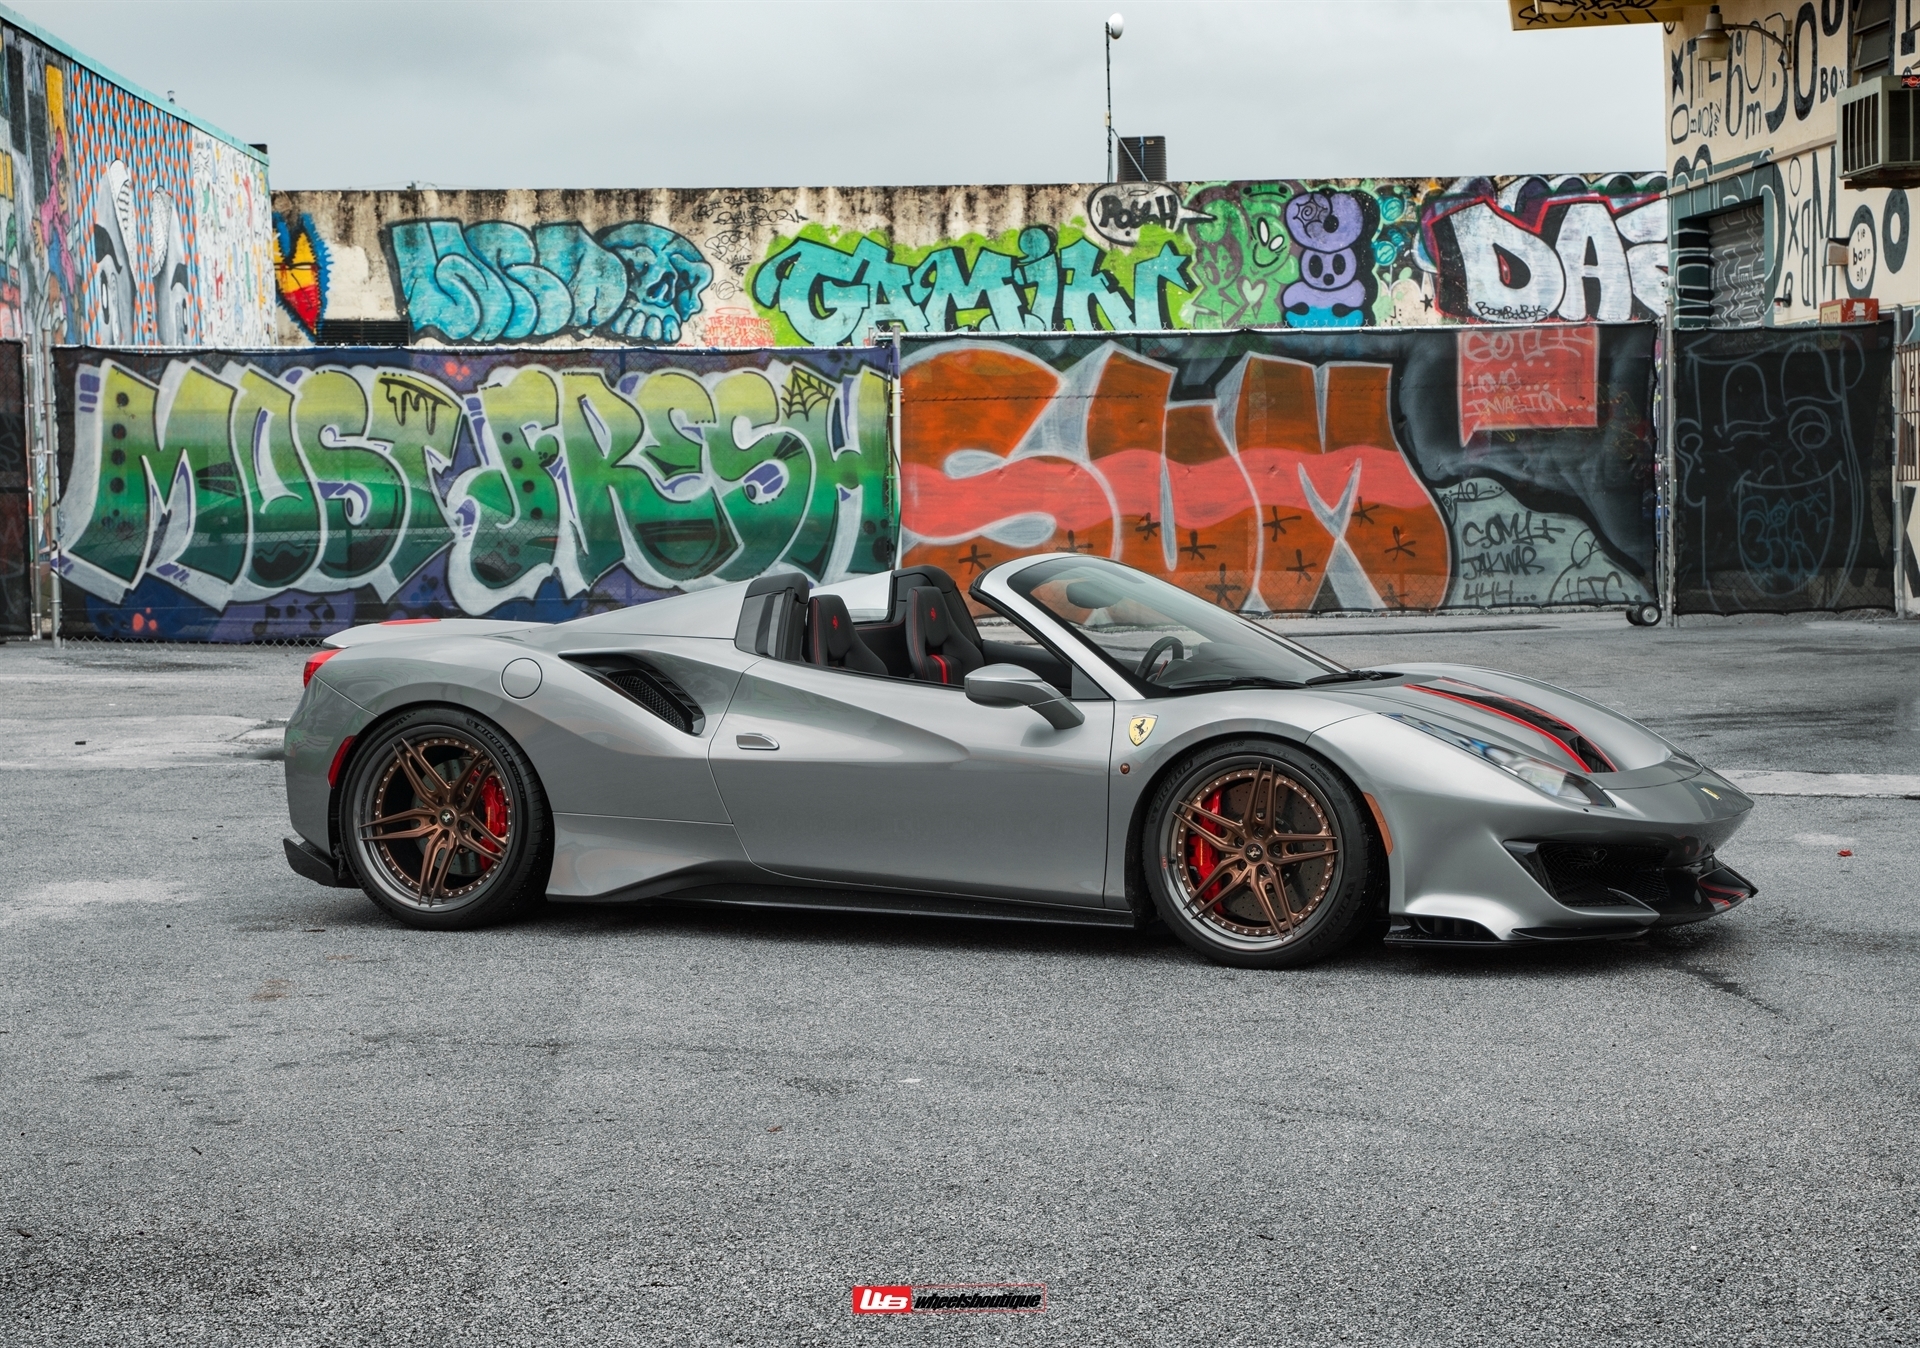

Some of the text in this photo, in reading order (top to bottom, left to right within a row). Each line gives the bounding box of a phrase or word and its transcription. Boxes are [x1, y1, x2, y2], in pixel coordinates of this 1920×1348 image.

[52, 358, 893, 617] MOST FRESH
[476, 725, 513, 762] MICHELIN
[1154, 760, 1192, 809] MICHELIN
